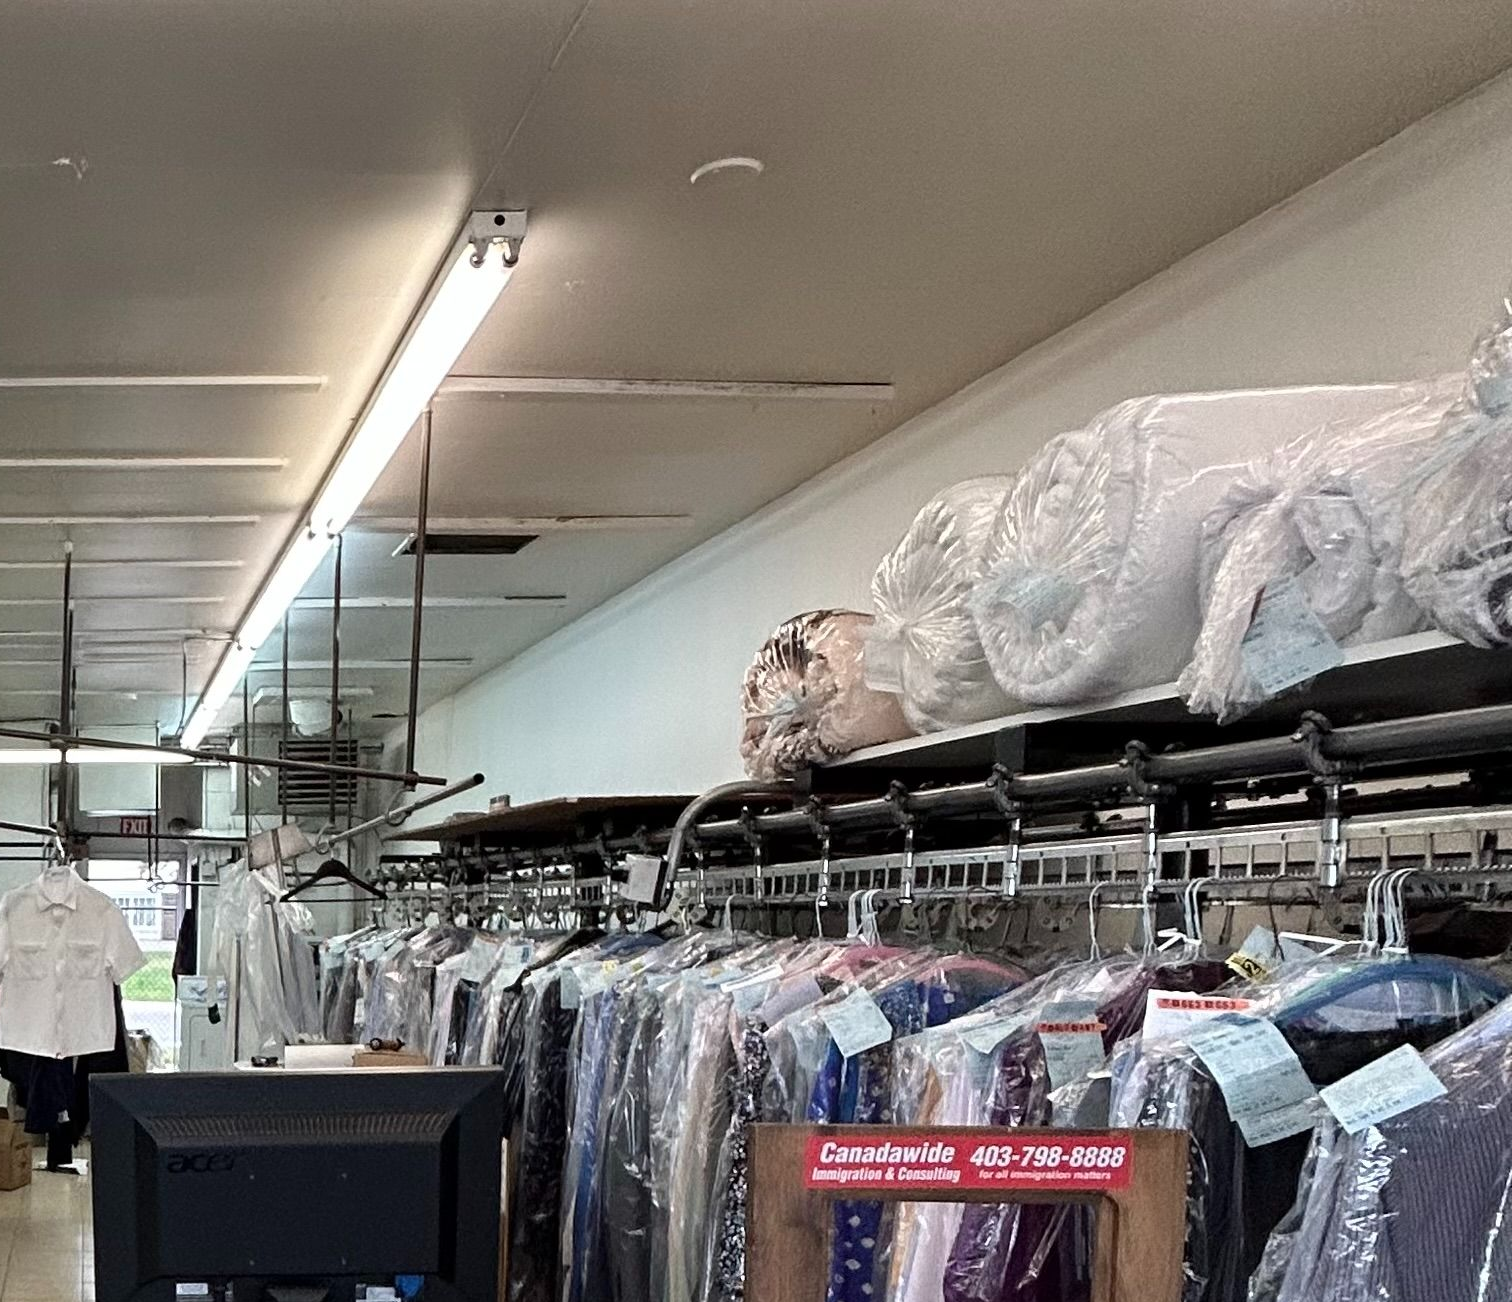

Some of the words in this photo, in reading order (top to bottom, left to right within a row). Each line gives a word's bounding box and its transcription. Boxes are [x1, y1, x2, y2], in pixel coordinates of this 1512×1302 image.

[122, 818, 148, 834] EXIT
[168, 1153, 241, 1173] acer
[819, 1141, 955, 1164] Canadawide
[969, 1145, 1127, 1168] 403-798-8888
[812, 1166, 883, 1183] Immigration
[885, 1167, 895, 1181] &
[897, 1166, 961, 1183] Consulting
[978, 1169, 994, 1180] for
[995, 1170, 1008, 1180] all
[1010, 1170, 1071, 1181] immigration
[1073, 1170, 1111, 1180] matters
